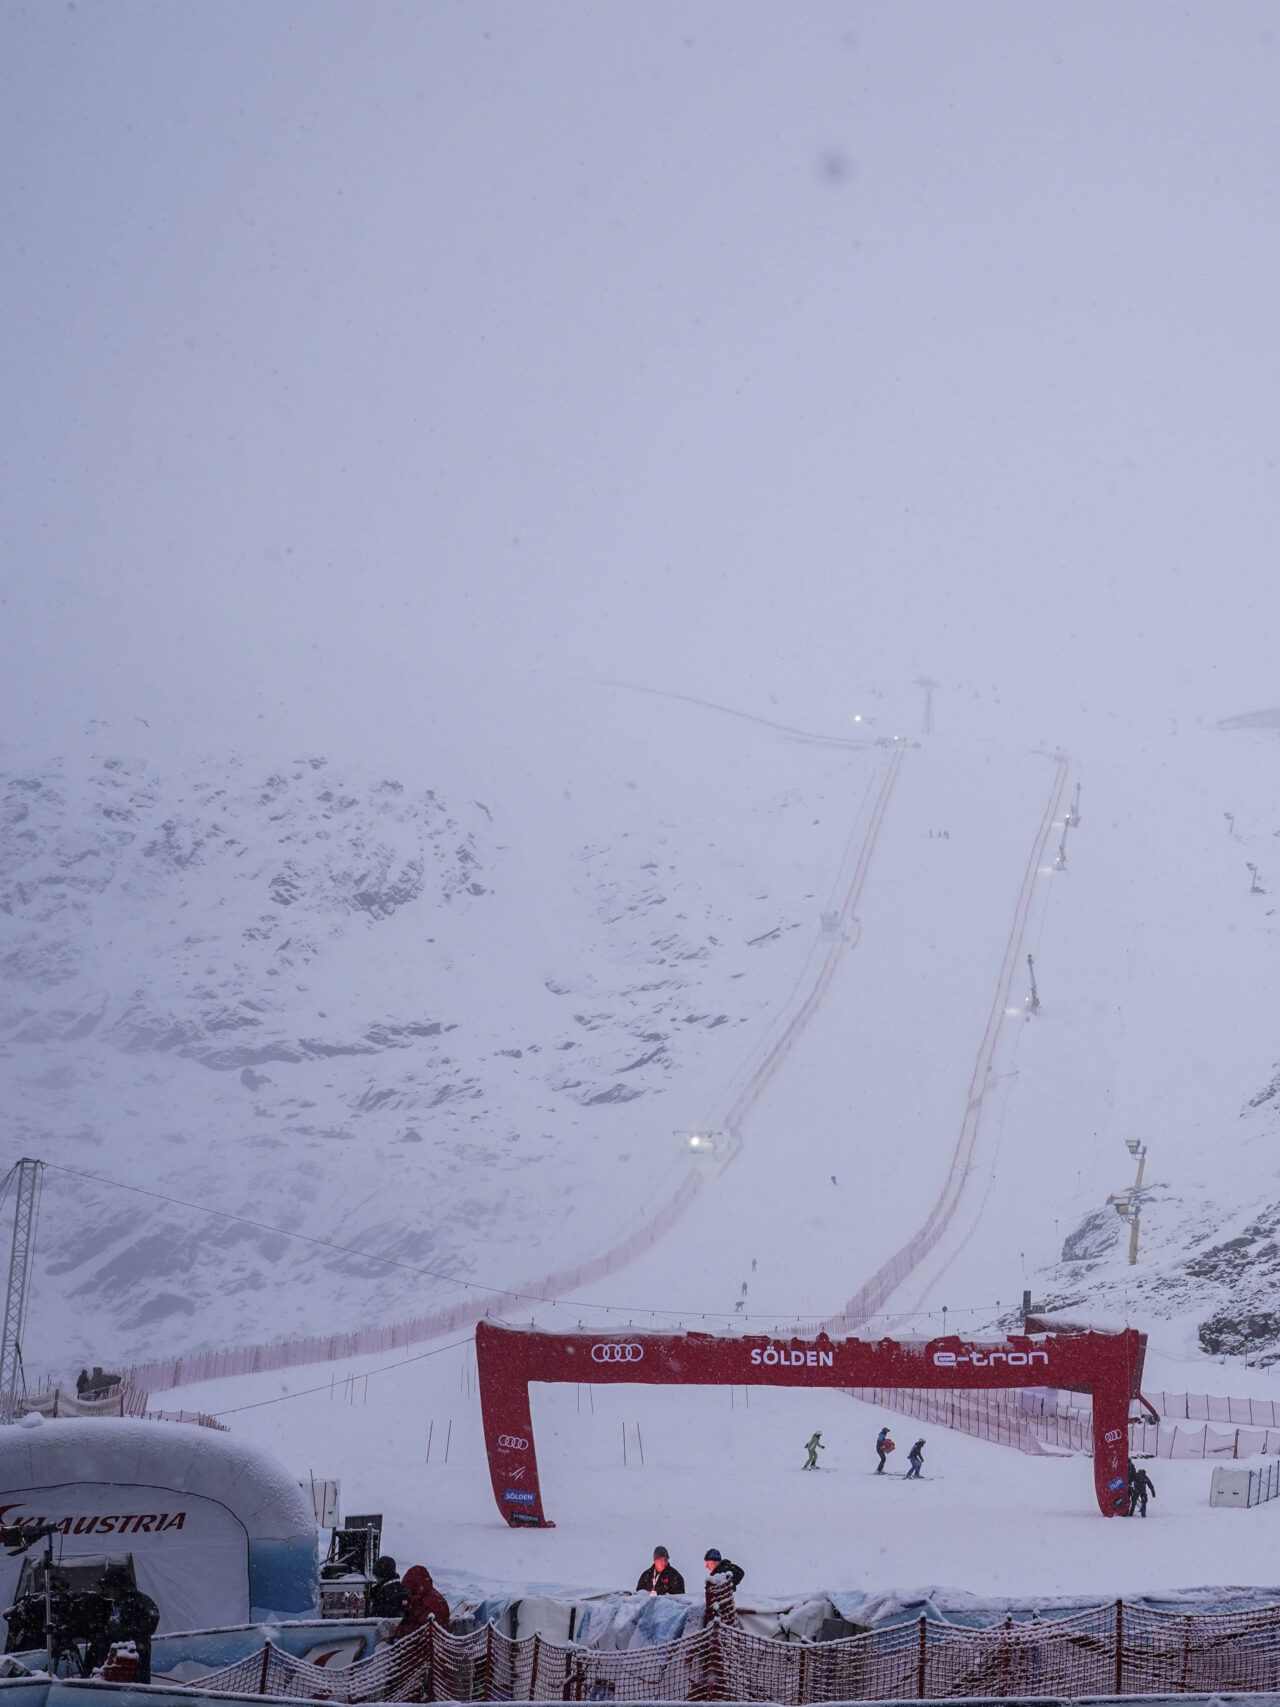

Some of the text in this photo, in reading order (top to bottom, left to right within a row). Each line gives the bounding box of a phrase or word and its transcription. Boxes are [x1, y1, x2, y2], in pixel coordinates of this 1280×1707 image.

[750, 1346, 833, 1366] SÖLDEN
[933, 1351, 1048, 1367] e-tron
[505, 1492, 533, 1501] SÖLDEN
[57, 1512, 187, 1535] AUSTRIA
